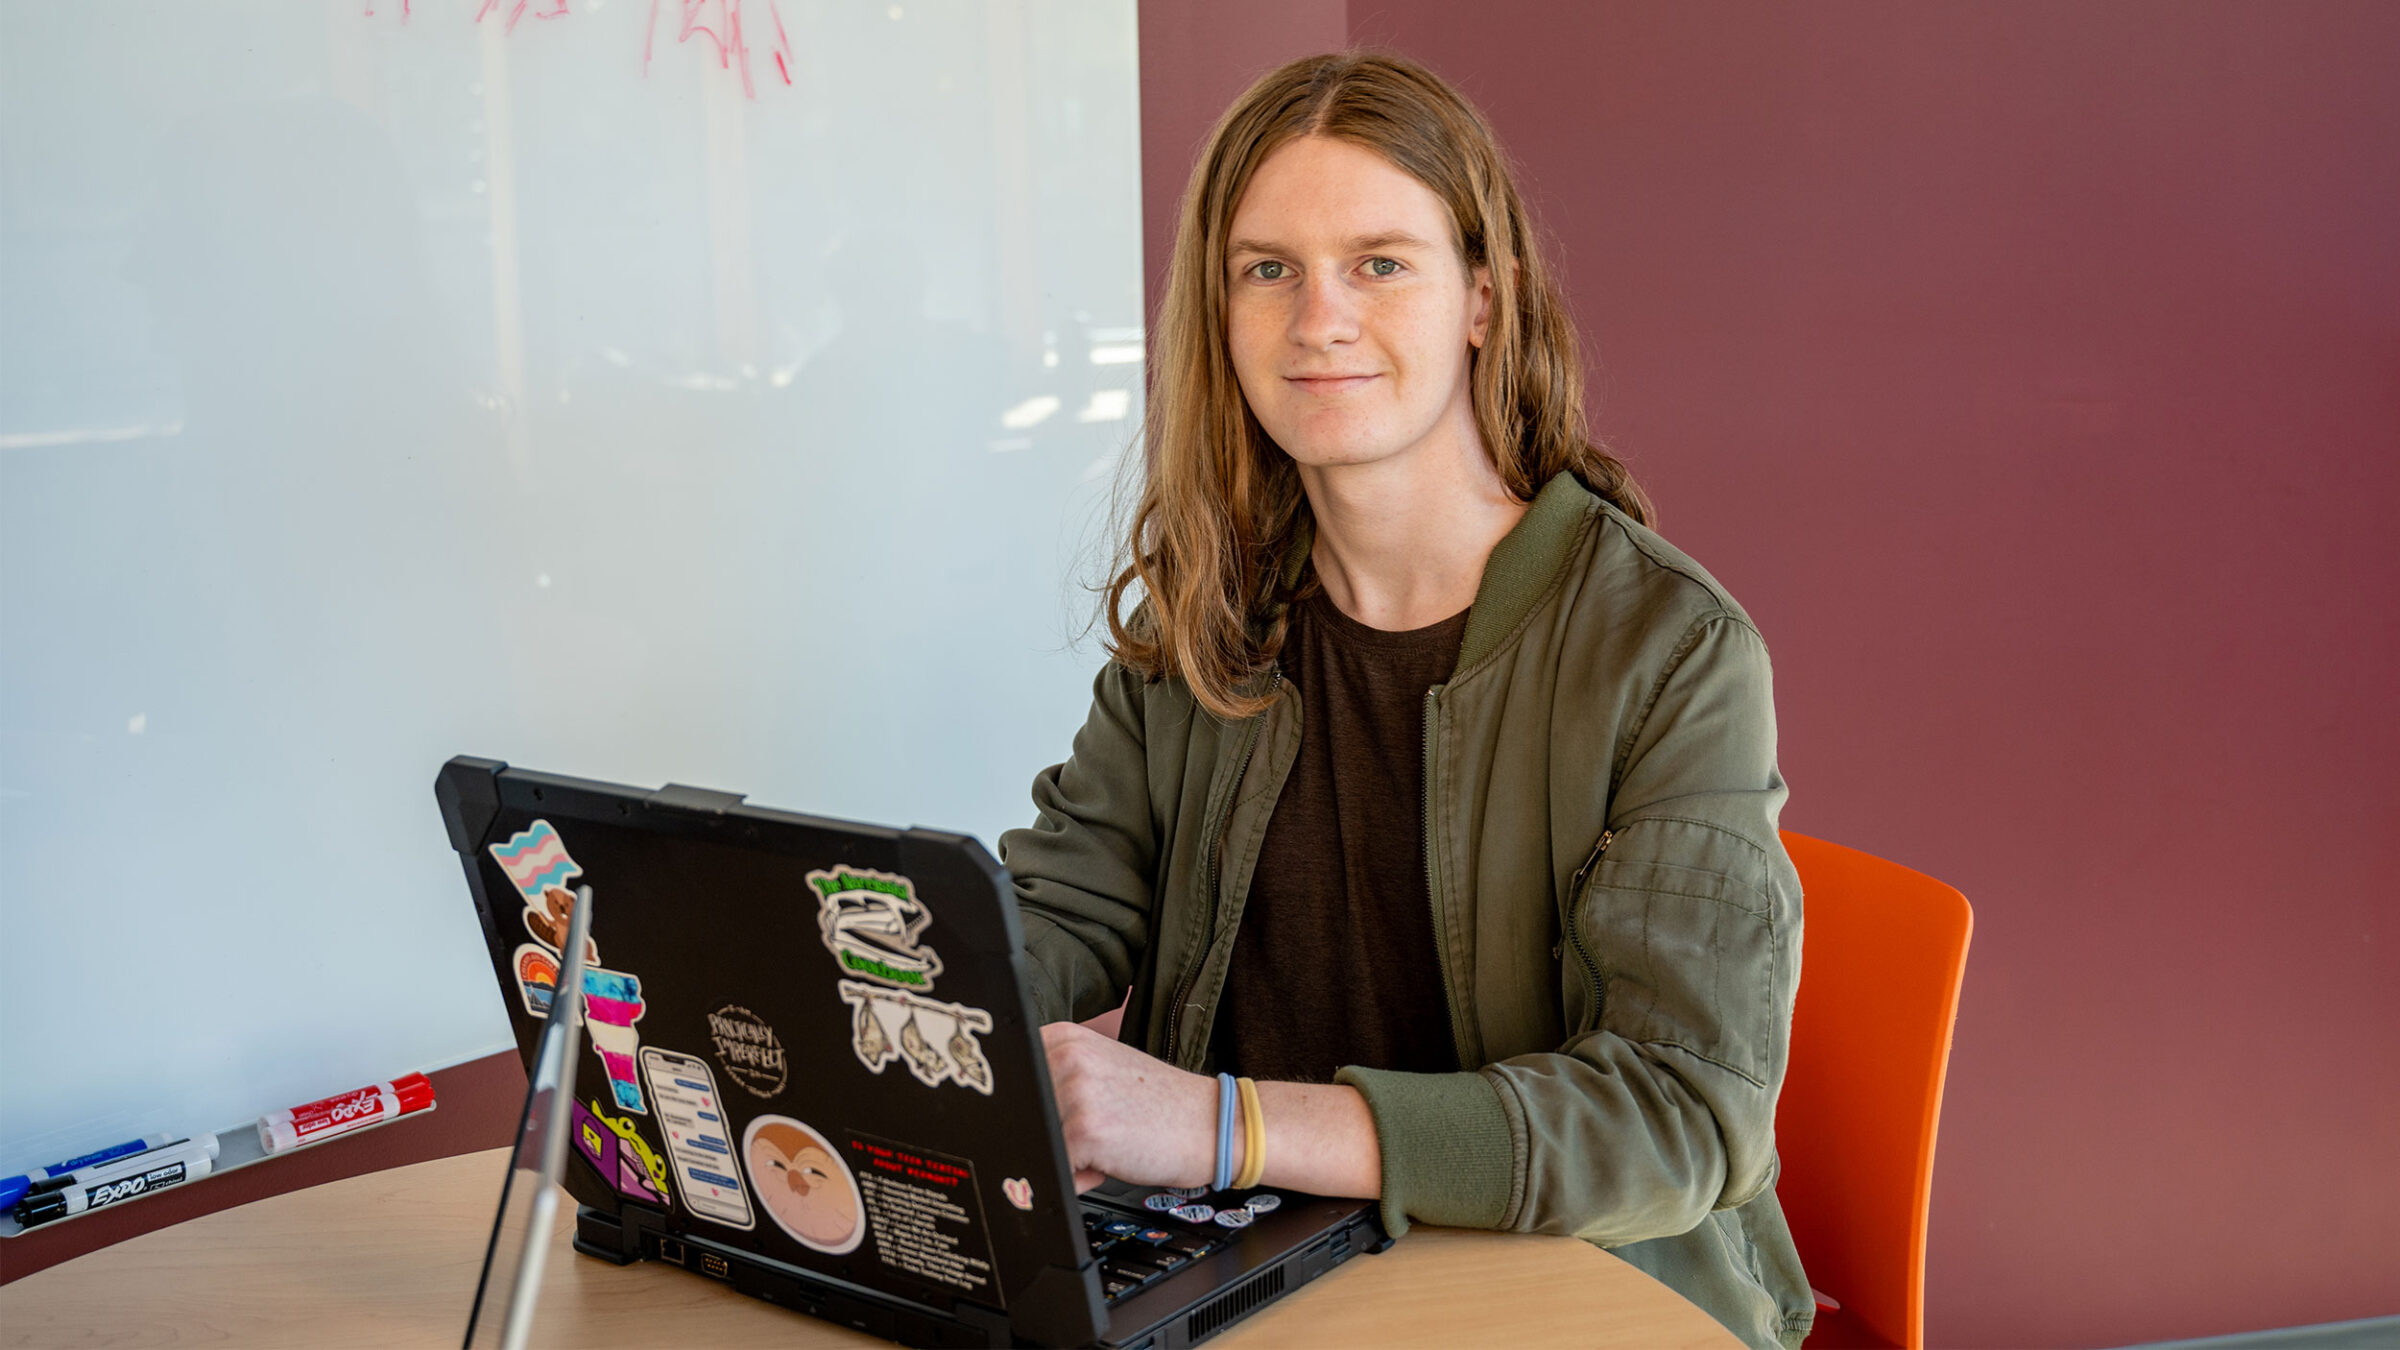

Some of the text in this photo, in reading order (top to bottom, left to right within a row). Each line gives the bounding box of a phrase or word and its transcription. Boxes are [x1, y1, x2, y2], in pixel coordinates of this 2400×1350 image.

[331, 1097, 376, 1121] EXPO
[163, 1166, 179, 1177] odor
[91, 1177, 145, 1205] EXPO
